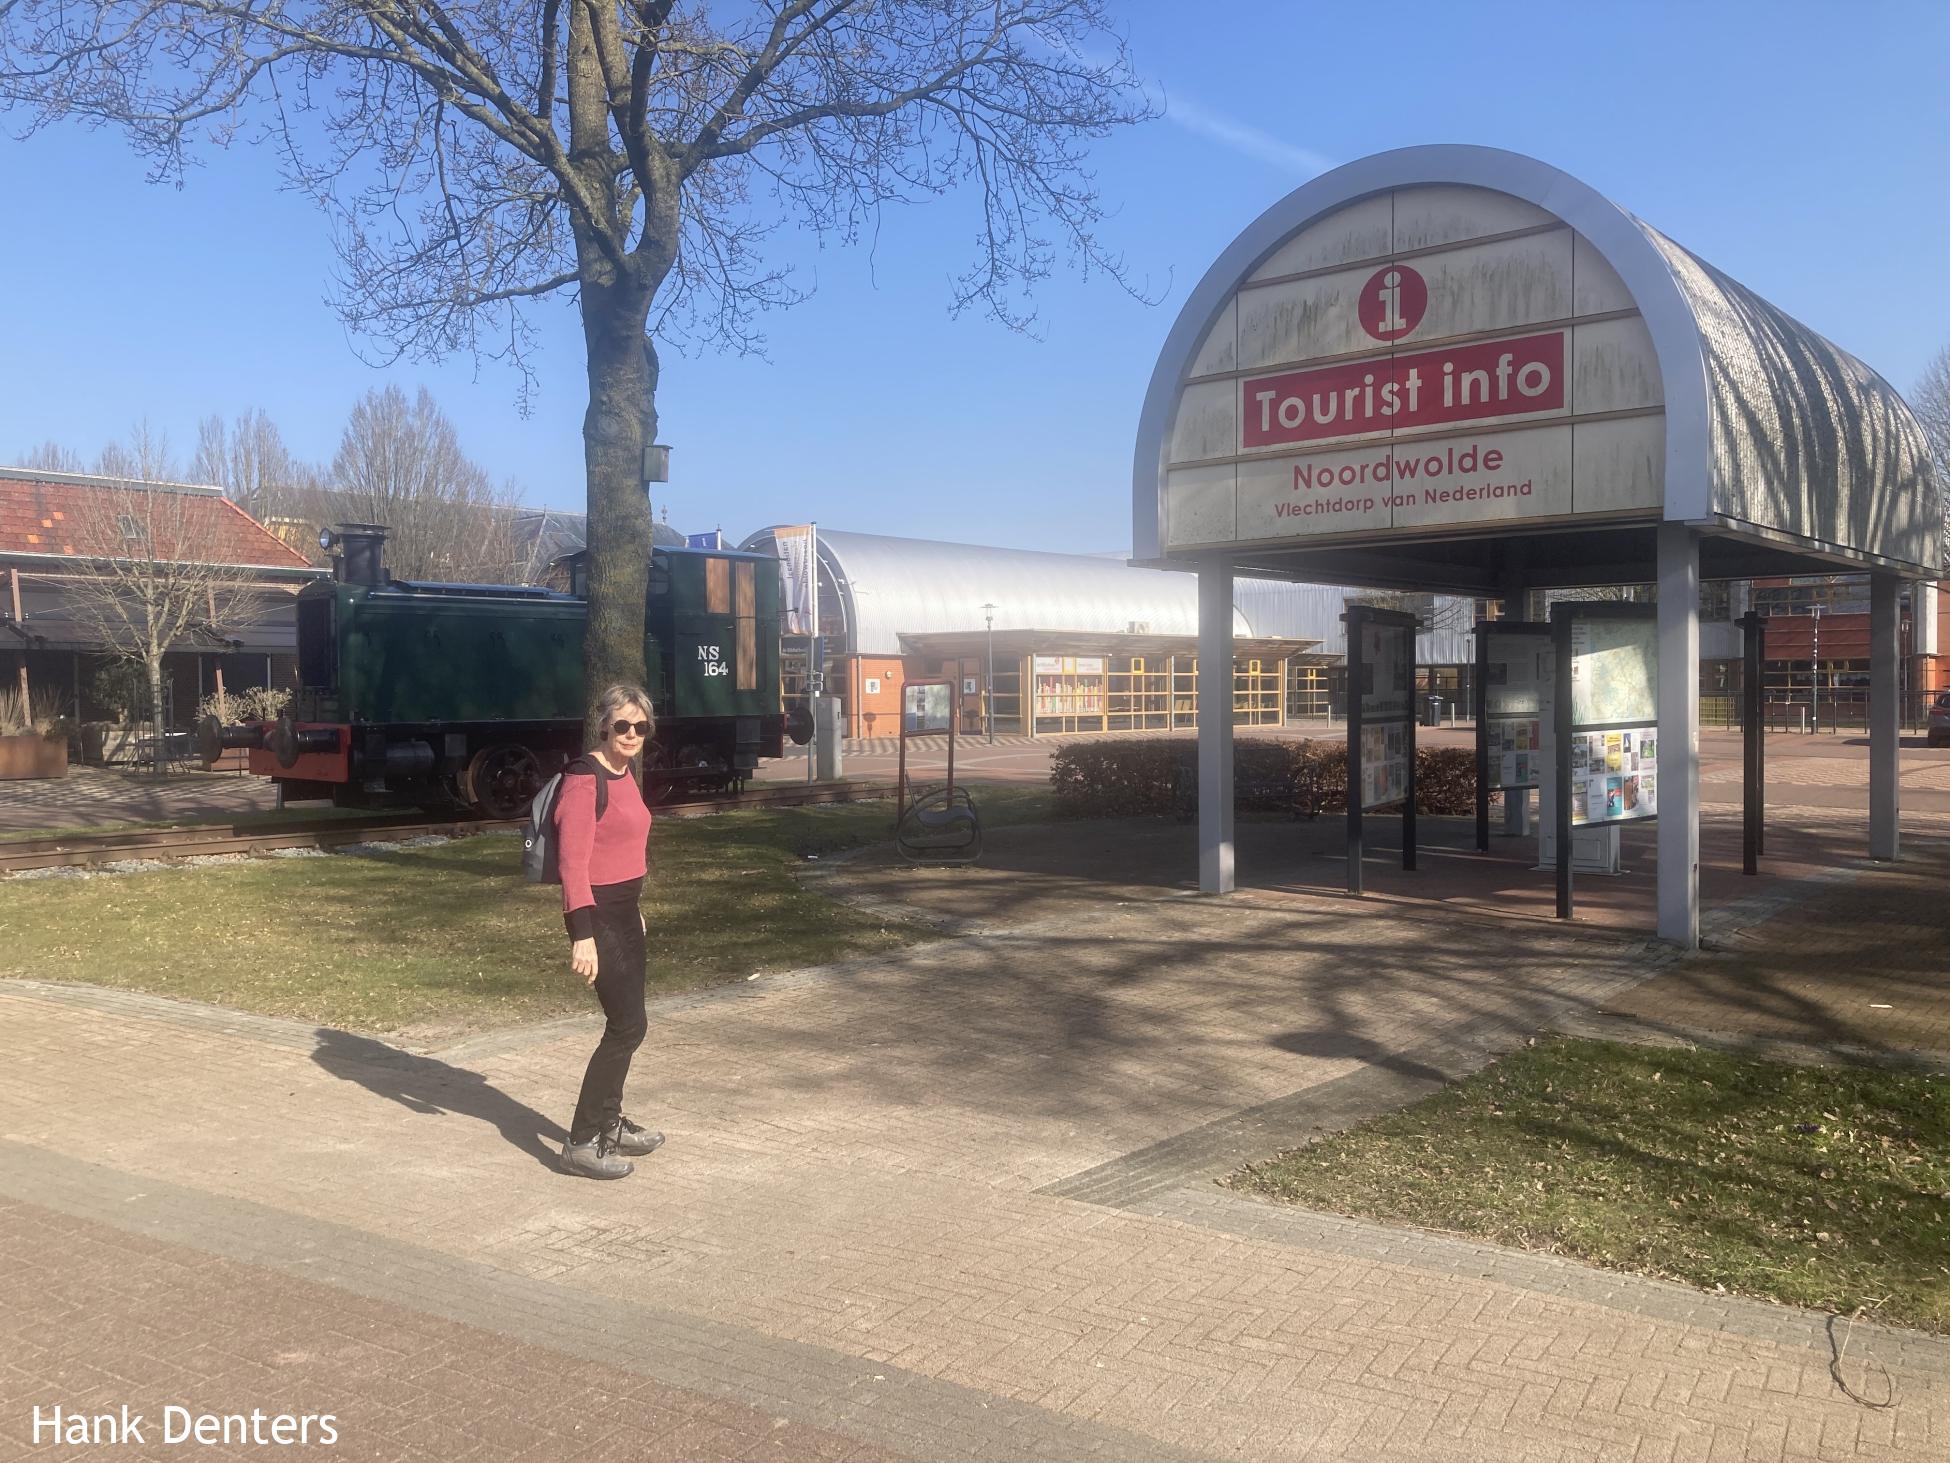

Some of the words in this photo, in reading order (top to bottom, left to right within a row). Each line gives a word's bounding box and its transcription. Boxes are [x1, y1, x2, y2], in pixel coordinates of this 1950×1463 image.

[1378, 271, 1406, 333] i
[1256, 368, 1422, 432] Tourist
[1443, 353, 1551, 408] info
[1293, 444, 1504, 490] Noordwolde
[1275, 497, 1374, 518] Vlechtdorp
[1382, 493, 1416, 508] van
[1424, 479, 1532, 504] Nederland
[697, 645, 720, 660] NS
[704, 661, 729, 676] 164
